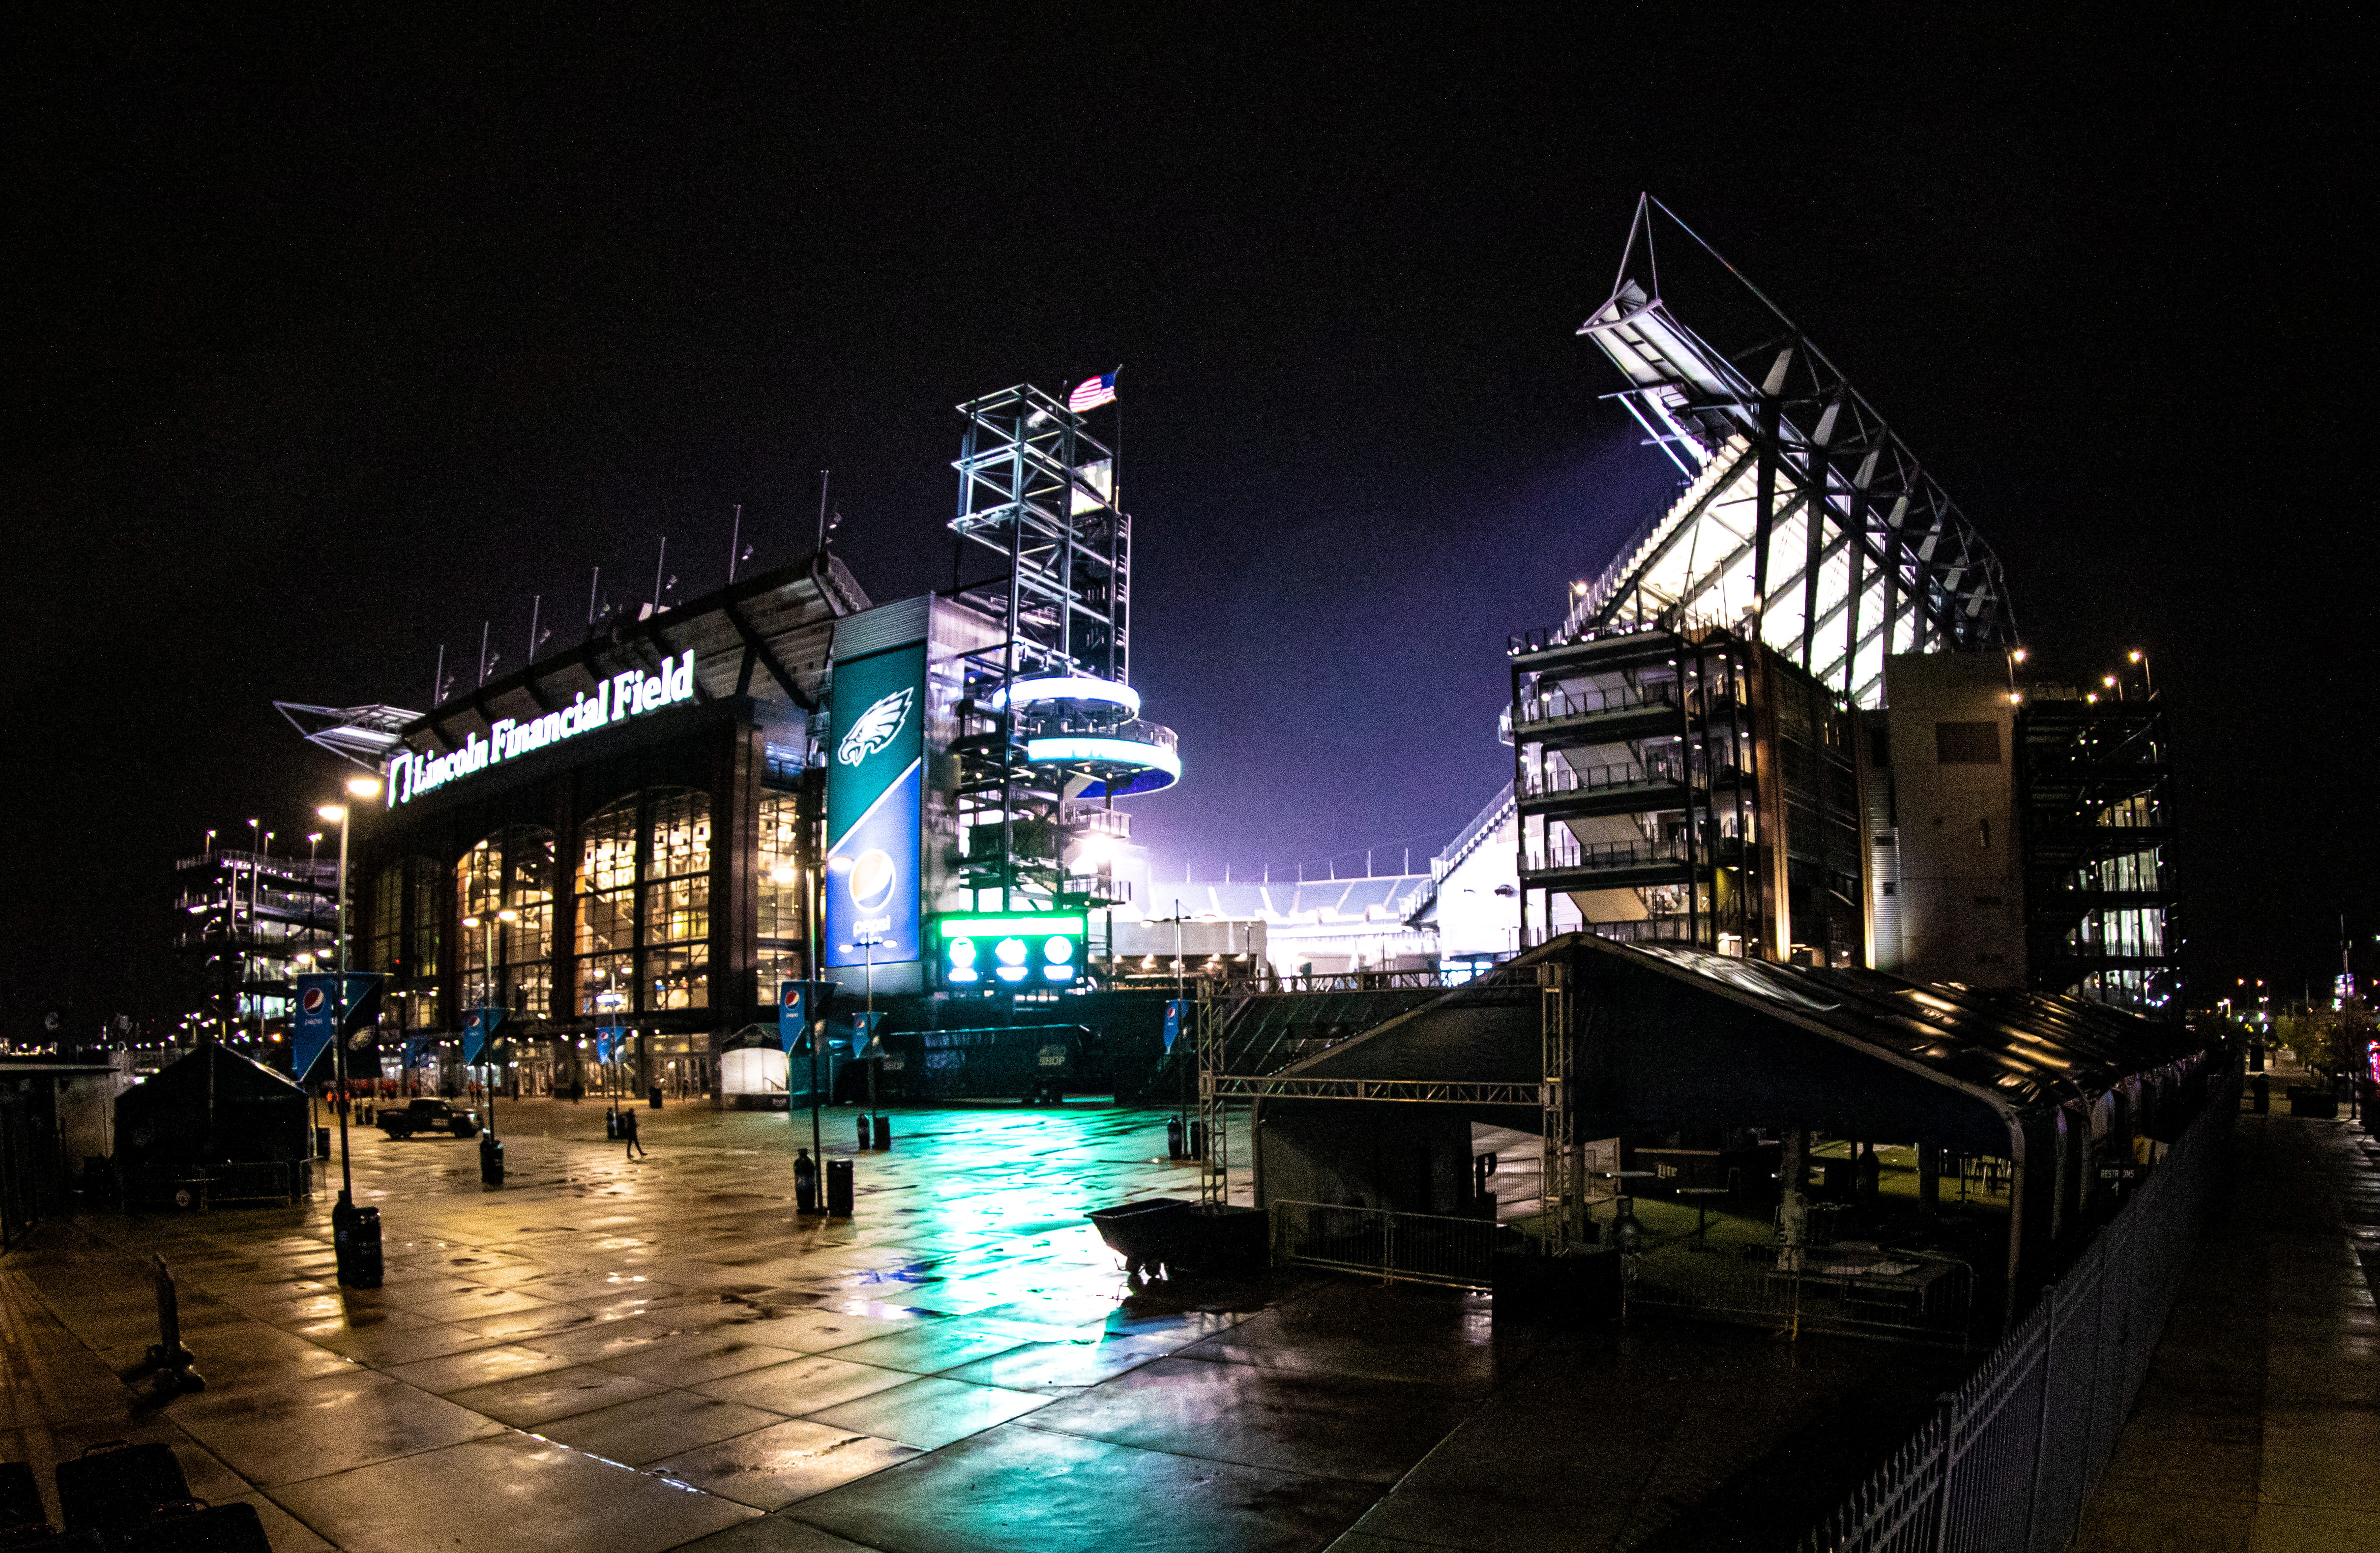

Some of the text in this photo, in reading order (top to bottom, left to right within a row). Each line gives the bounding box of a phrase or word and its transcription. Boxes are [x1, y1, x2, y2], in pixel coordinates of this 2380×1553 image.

[412, 649, 694, 794] Lincoln Financial Field
